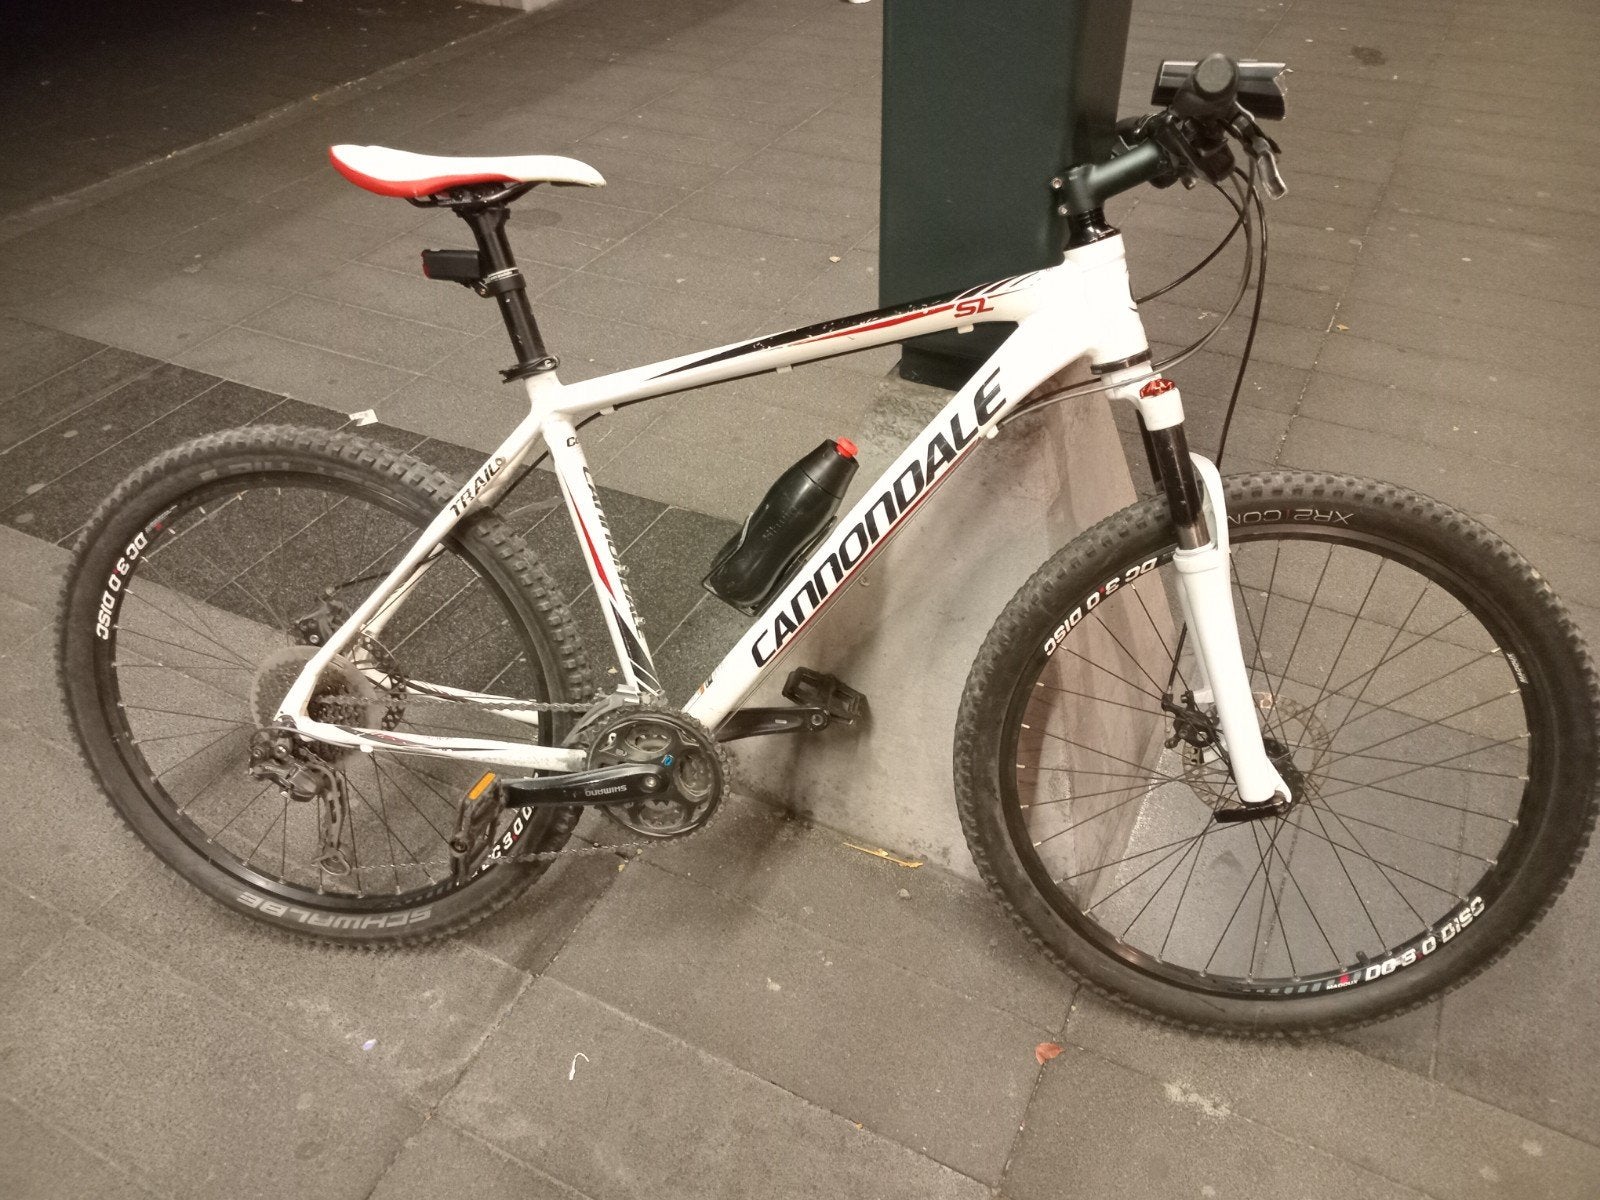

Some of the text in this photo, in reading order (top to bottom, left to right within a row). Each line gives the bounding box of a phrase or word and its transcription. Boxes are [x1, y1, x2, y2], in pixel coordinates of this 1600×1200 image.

[954, 297, 994, 318] SL
[1294, 509, 1354, 525] XR2
[126, 532, 148, 560] DC
[1125, 557, 1157, 582] DC
[96, 588, 115, 640] DISC
[1044, 605, 1083, 656] DISC
[585, 785, 627, 796] SHIMANO
[236, 891, 432, 930] SCHWALBE
[1365, 958, 1397, 981] DC
[1440, 896, 1485, 943] DISC
